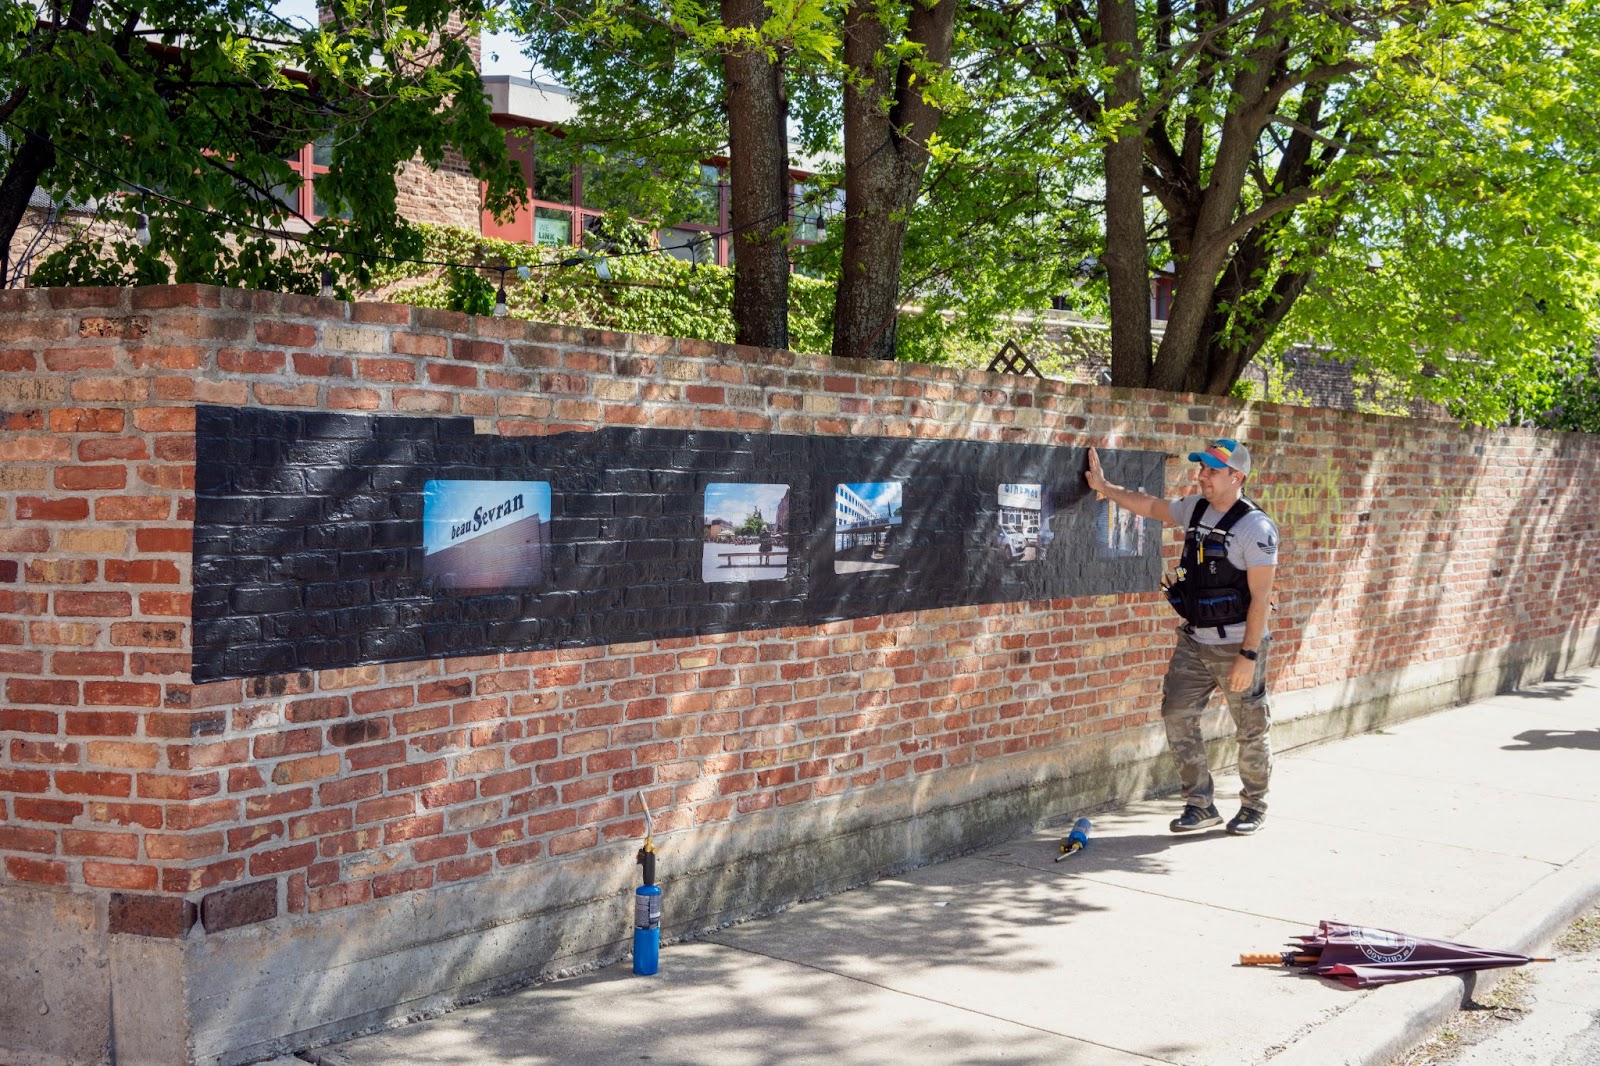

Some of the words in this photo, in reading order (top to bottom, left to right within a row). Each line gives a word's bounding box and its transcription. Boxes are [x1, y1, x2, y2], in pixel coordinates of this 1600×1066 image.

[451, 521, 471, 540] beau
[472, 493, 525, 532] Sevran
[1366, 948, 1403, 963] CHICAGO
